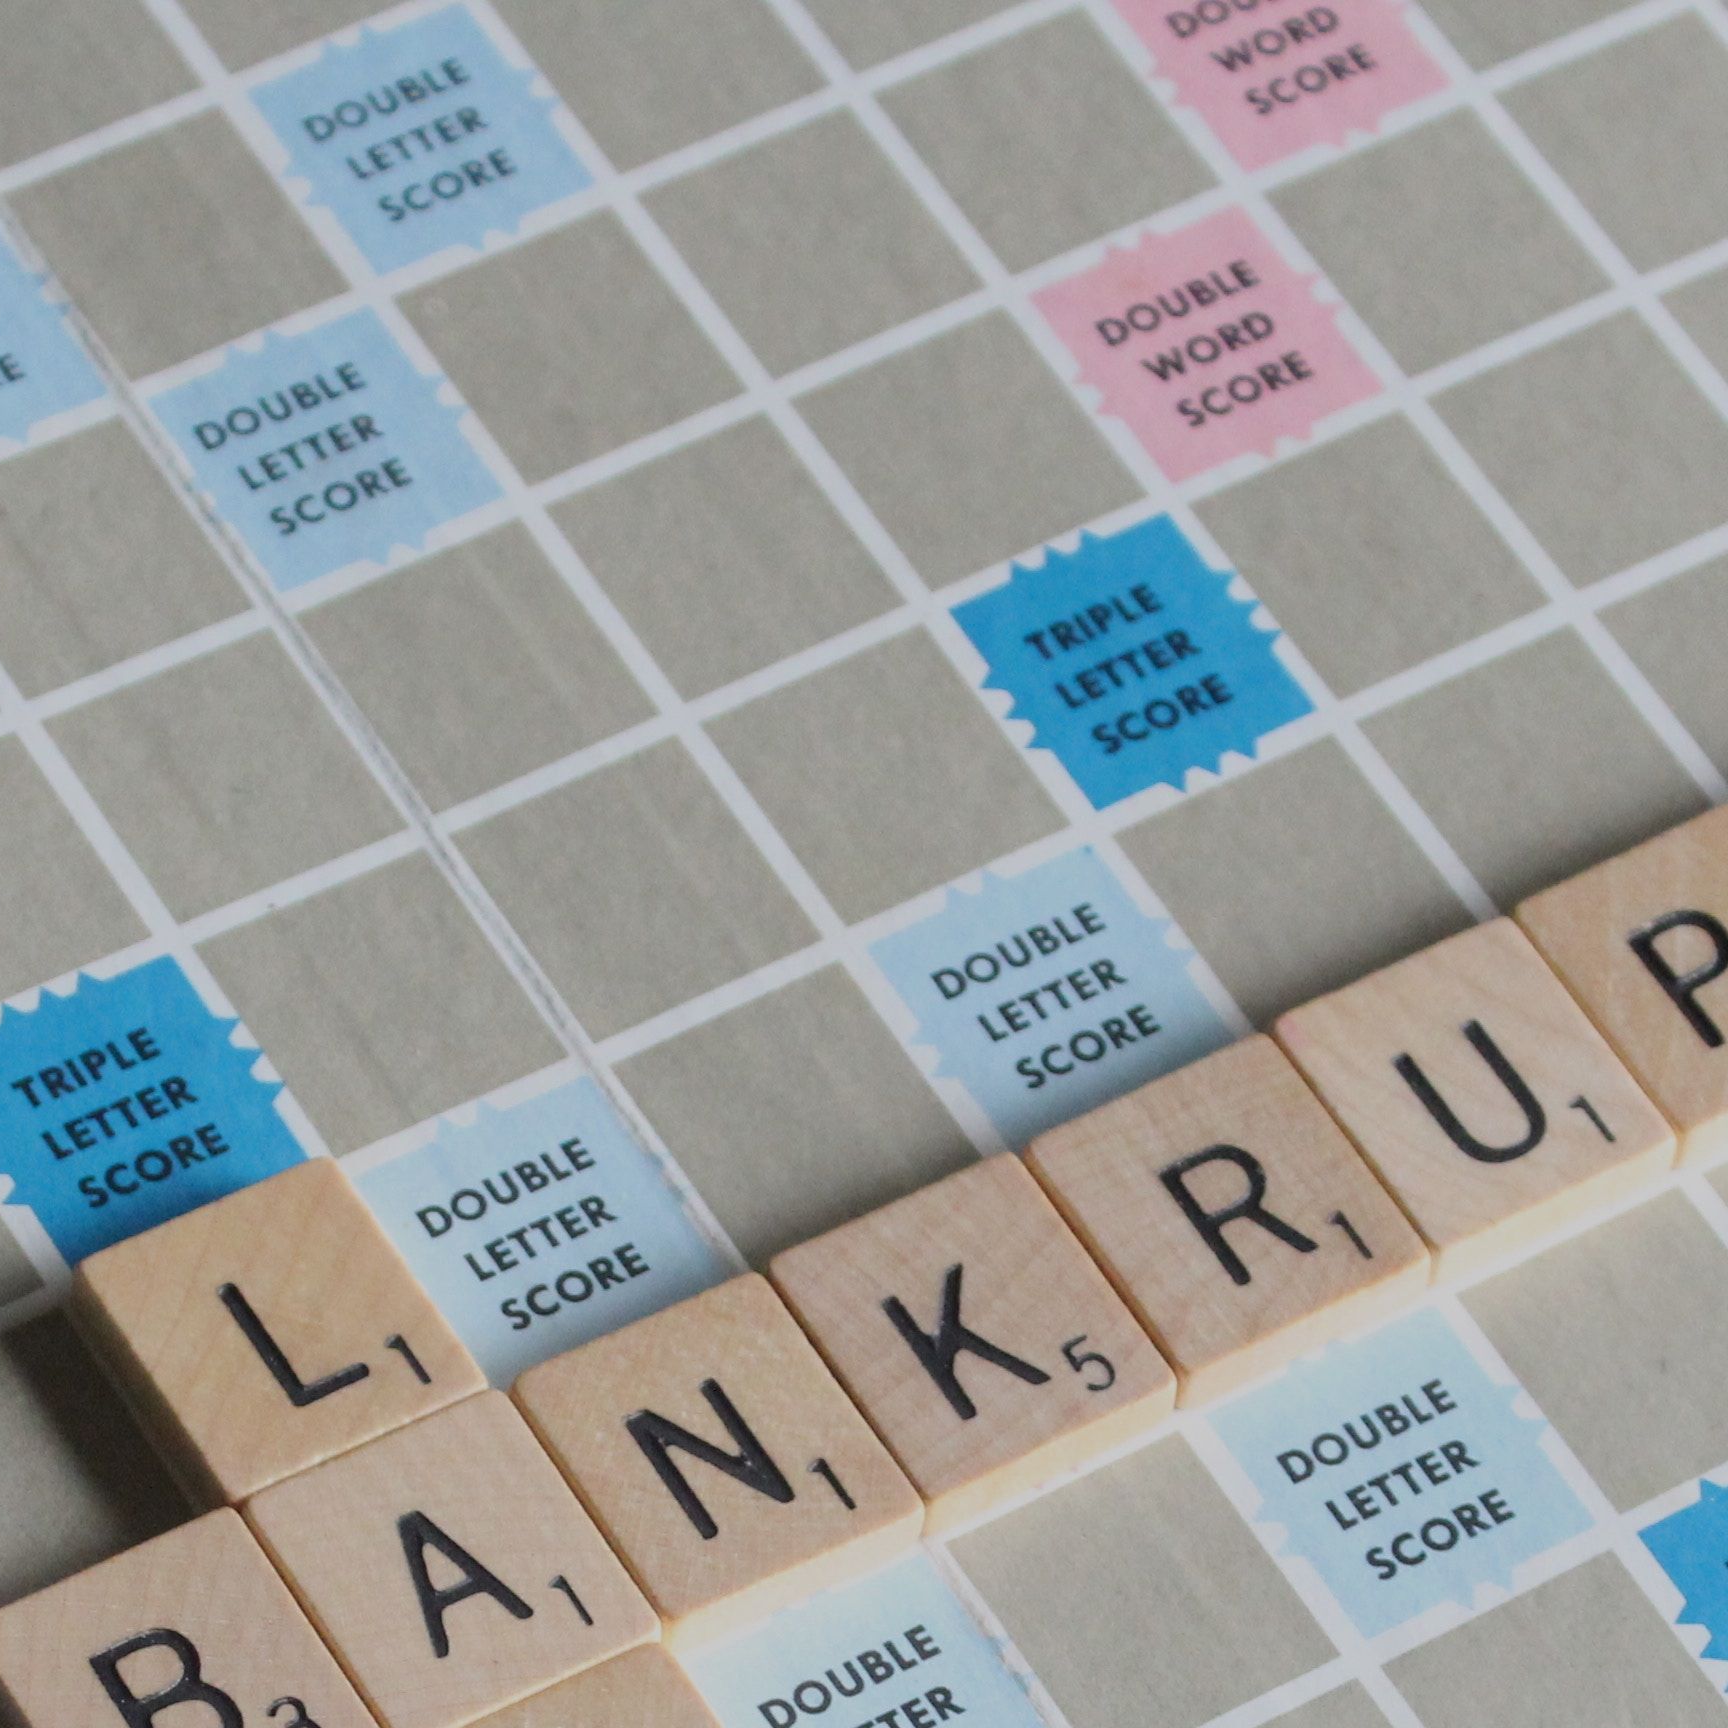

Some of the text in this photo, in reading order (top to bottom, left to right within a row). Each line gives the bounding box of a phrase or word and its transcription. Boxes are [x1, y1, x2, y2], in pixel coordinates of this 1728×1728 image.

[1208, 6, 1340, 74] WORD
[1243, 42, 1377, 117] SCORE
[301, 58, 471, 145] DOUBLE
[345, 107, 488, 182] LETTER
[376, 148, 517, 225] SCORE
[1093, 259, 1261, 348] DOUBLE
[1139, 311, 1275, 384] WORD
[1175, 350, 1314, 429] SCORE
[192, 361, 367, 453] DOUBLE
[236, 414, 384, 493] LETTER
[268, 458, 414, 537] SCORE
[1022, 583, 1165, 661] TRIPLE
[1053, 629, 1202, 711] LETTER
[1090, 673, 1234, 756] SCORE
[929, 902, 1107, 1002] DOUBLE
[976, 958, 1128, 1044] LETTER
[9, 1026, 163, 1110] TRIPLE
[1014, 1003, 1162, 1091] SCORE
[39, 1075, 200, 1162] LETTER
[76, 1122, 231, 1210] SCORE
[414, 1136, 597, 1240] DOUBLE
[462, 1194, 619, 1283] LETTER
[499, 1242, 652, 1332] SCORE
[1275, 1378, 1458, 1486] DOUBLE
[1323, 1439, 1481, 1532] LETTER
[1364, 1487, 1517, 1582] SCORE
